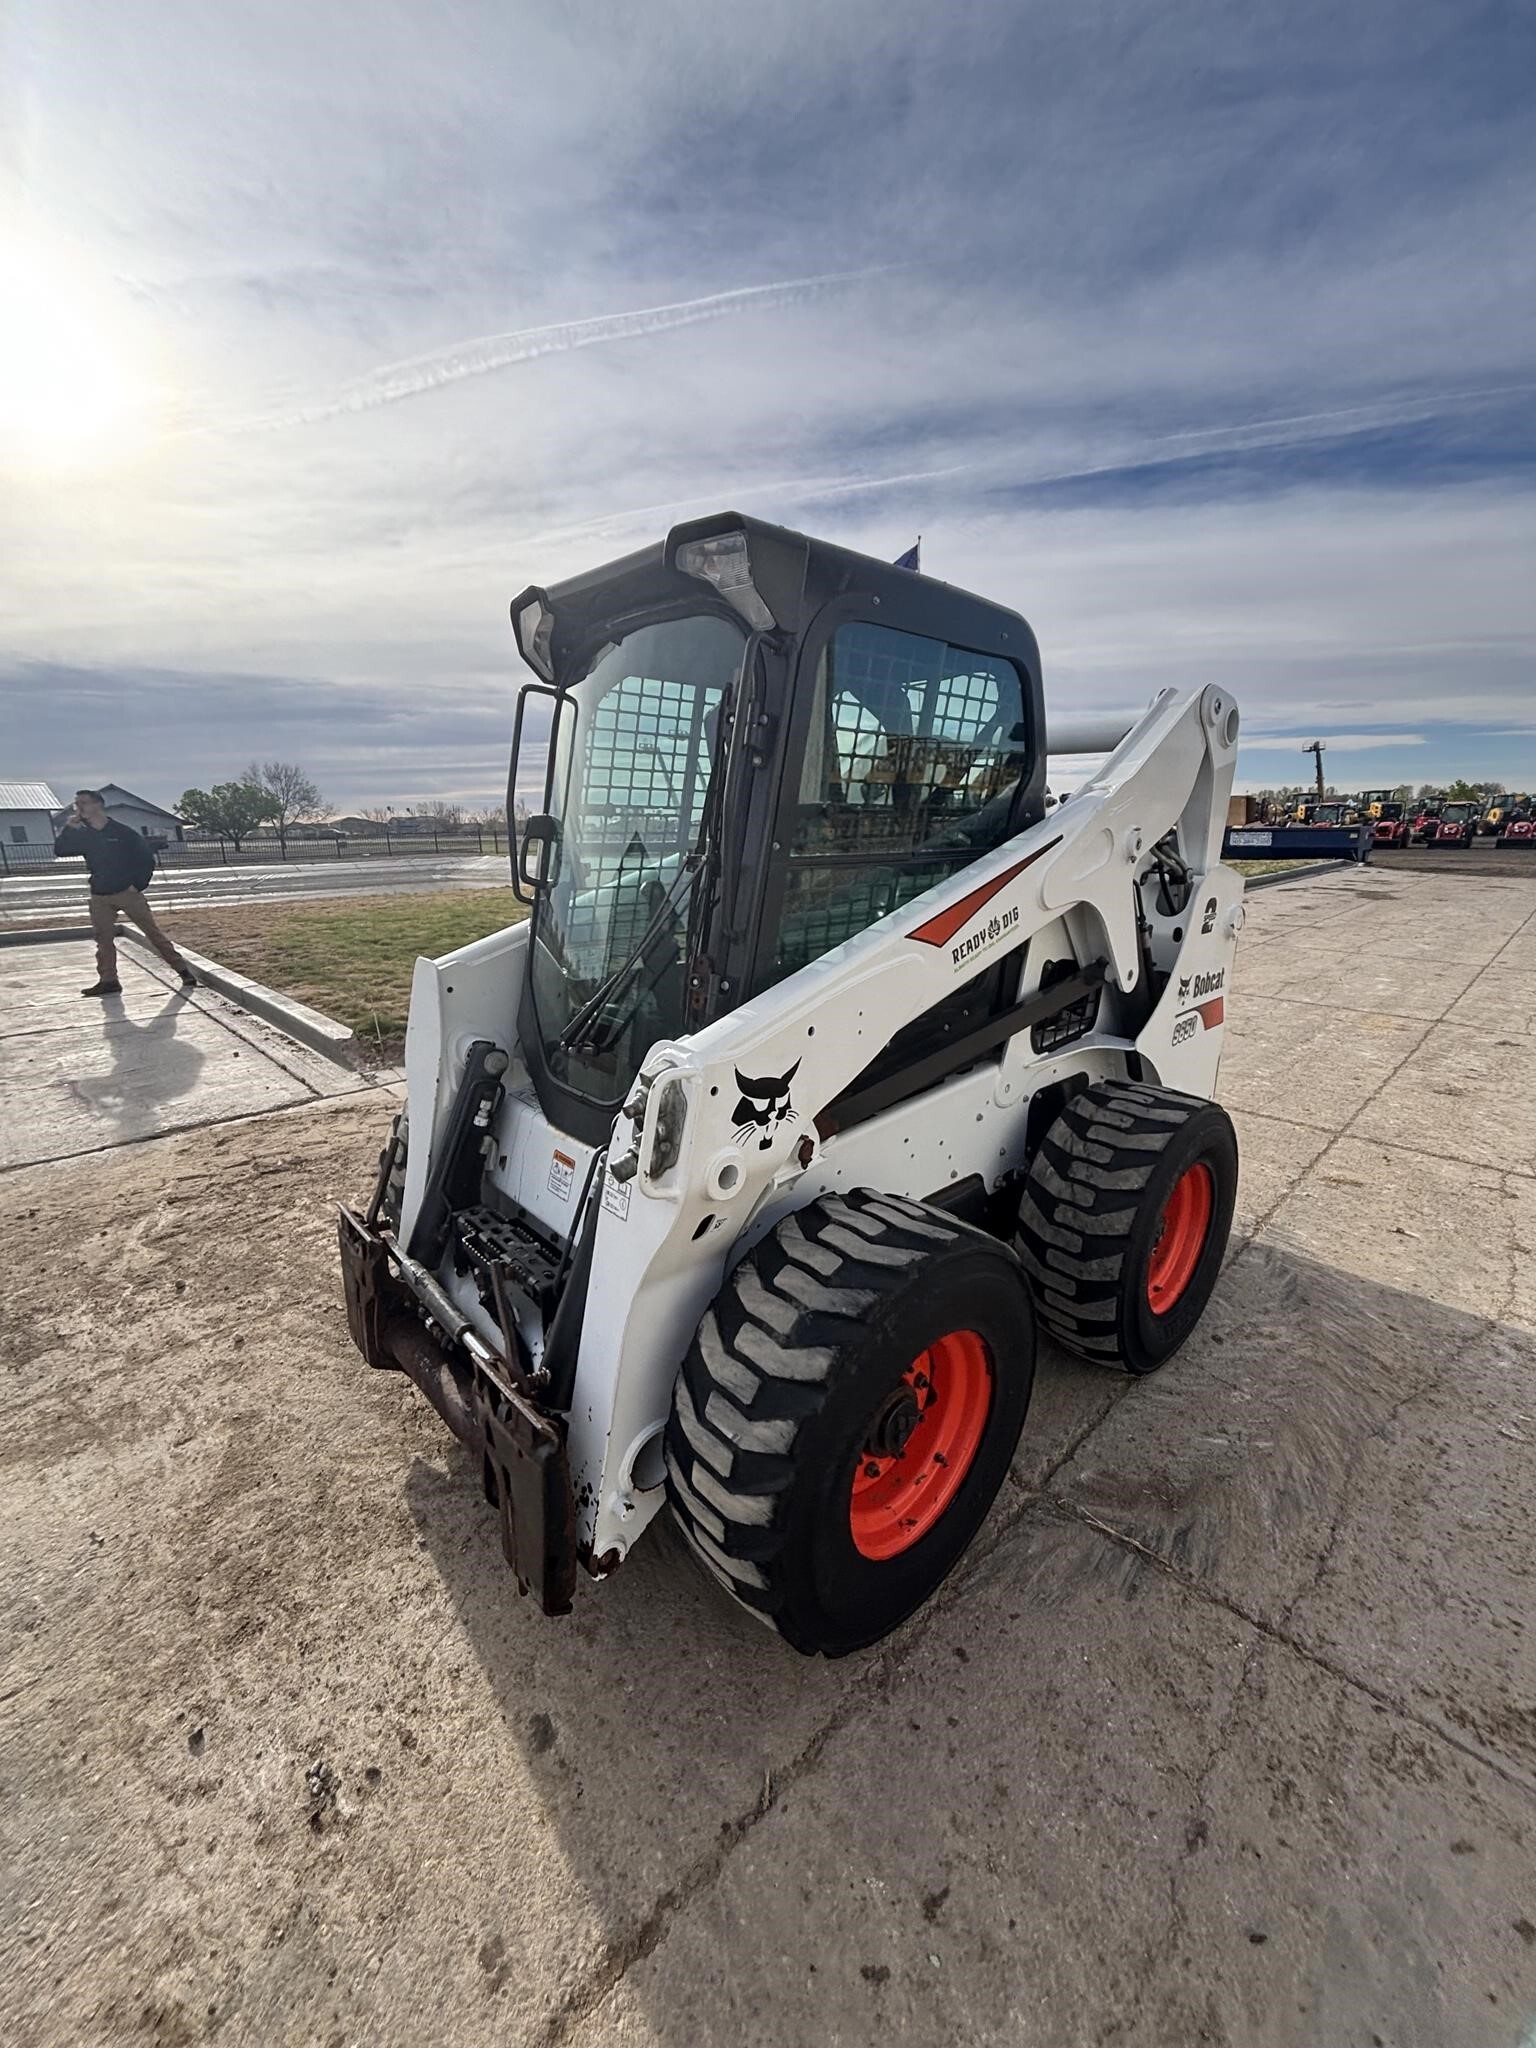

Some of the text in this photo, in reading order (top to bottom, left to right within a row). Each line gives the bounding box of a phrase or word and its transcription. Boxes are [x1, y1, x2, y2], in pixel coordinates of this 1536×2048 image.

[952, 928, 986, 964] READY
[1002, 906, 1019, 929] DIG
[1193, 967, 1224, 998] Bobcat
